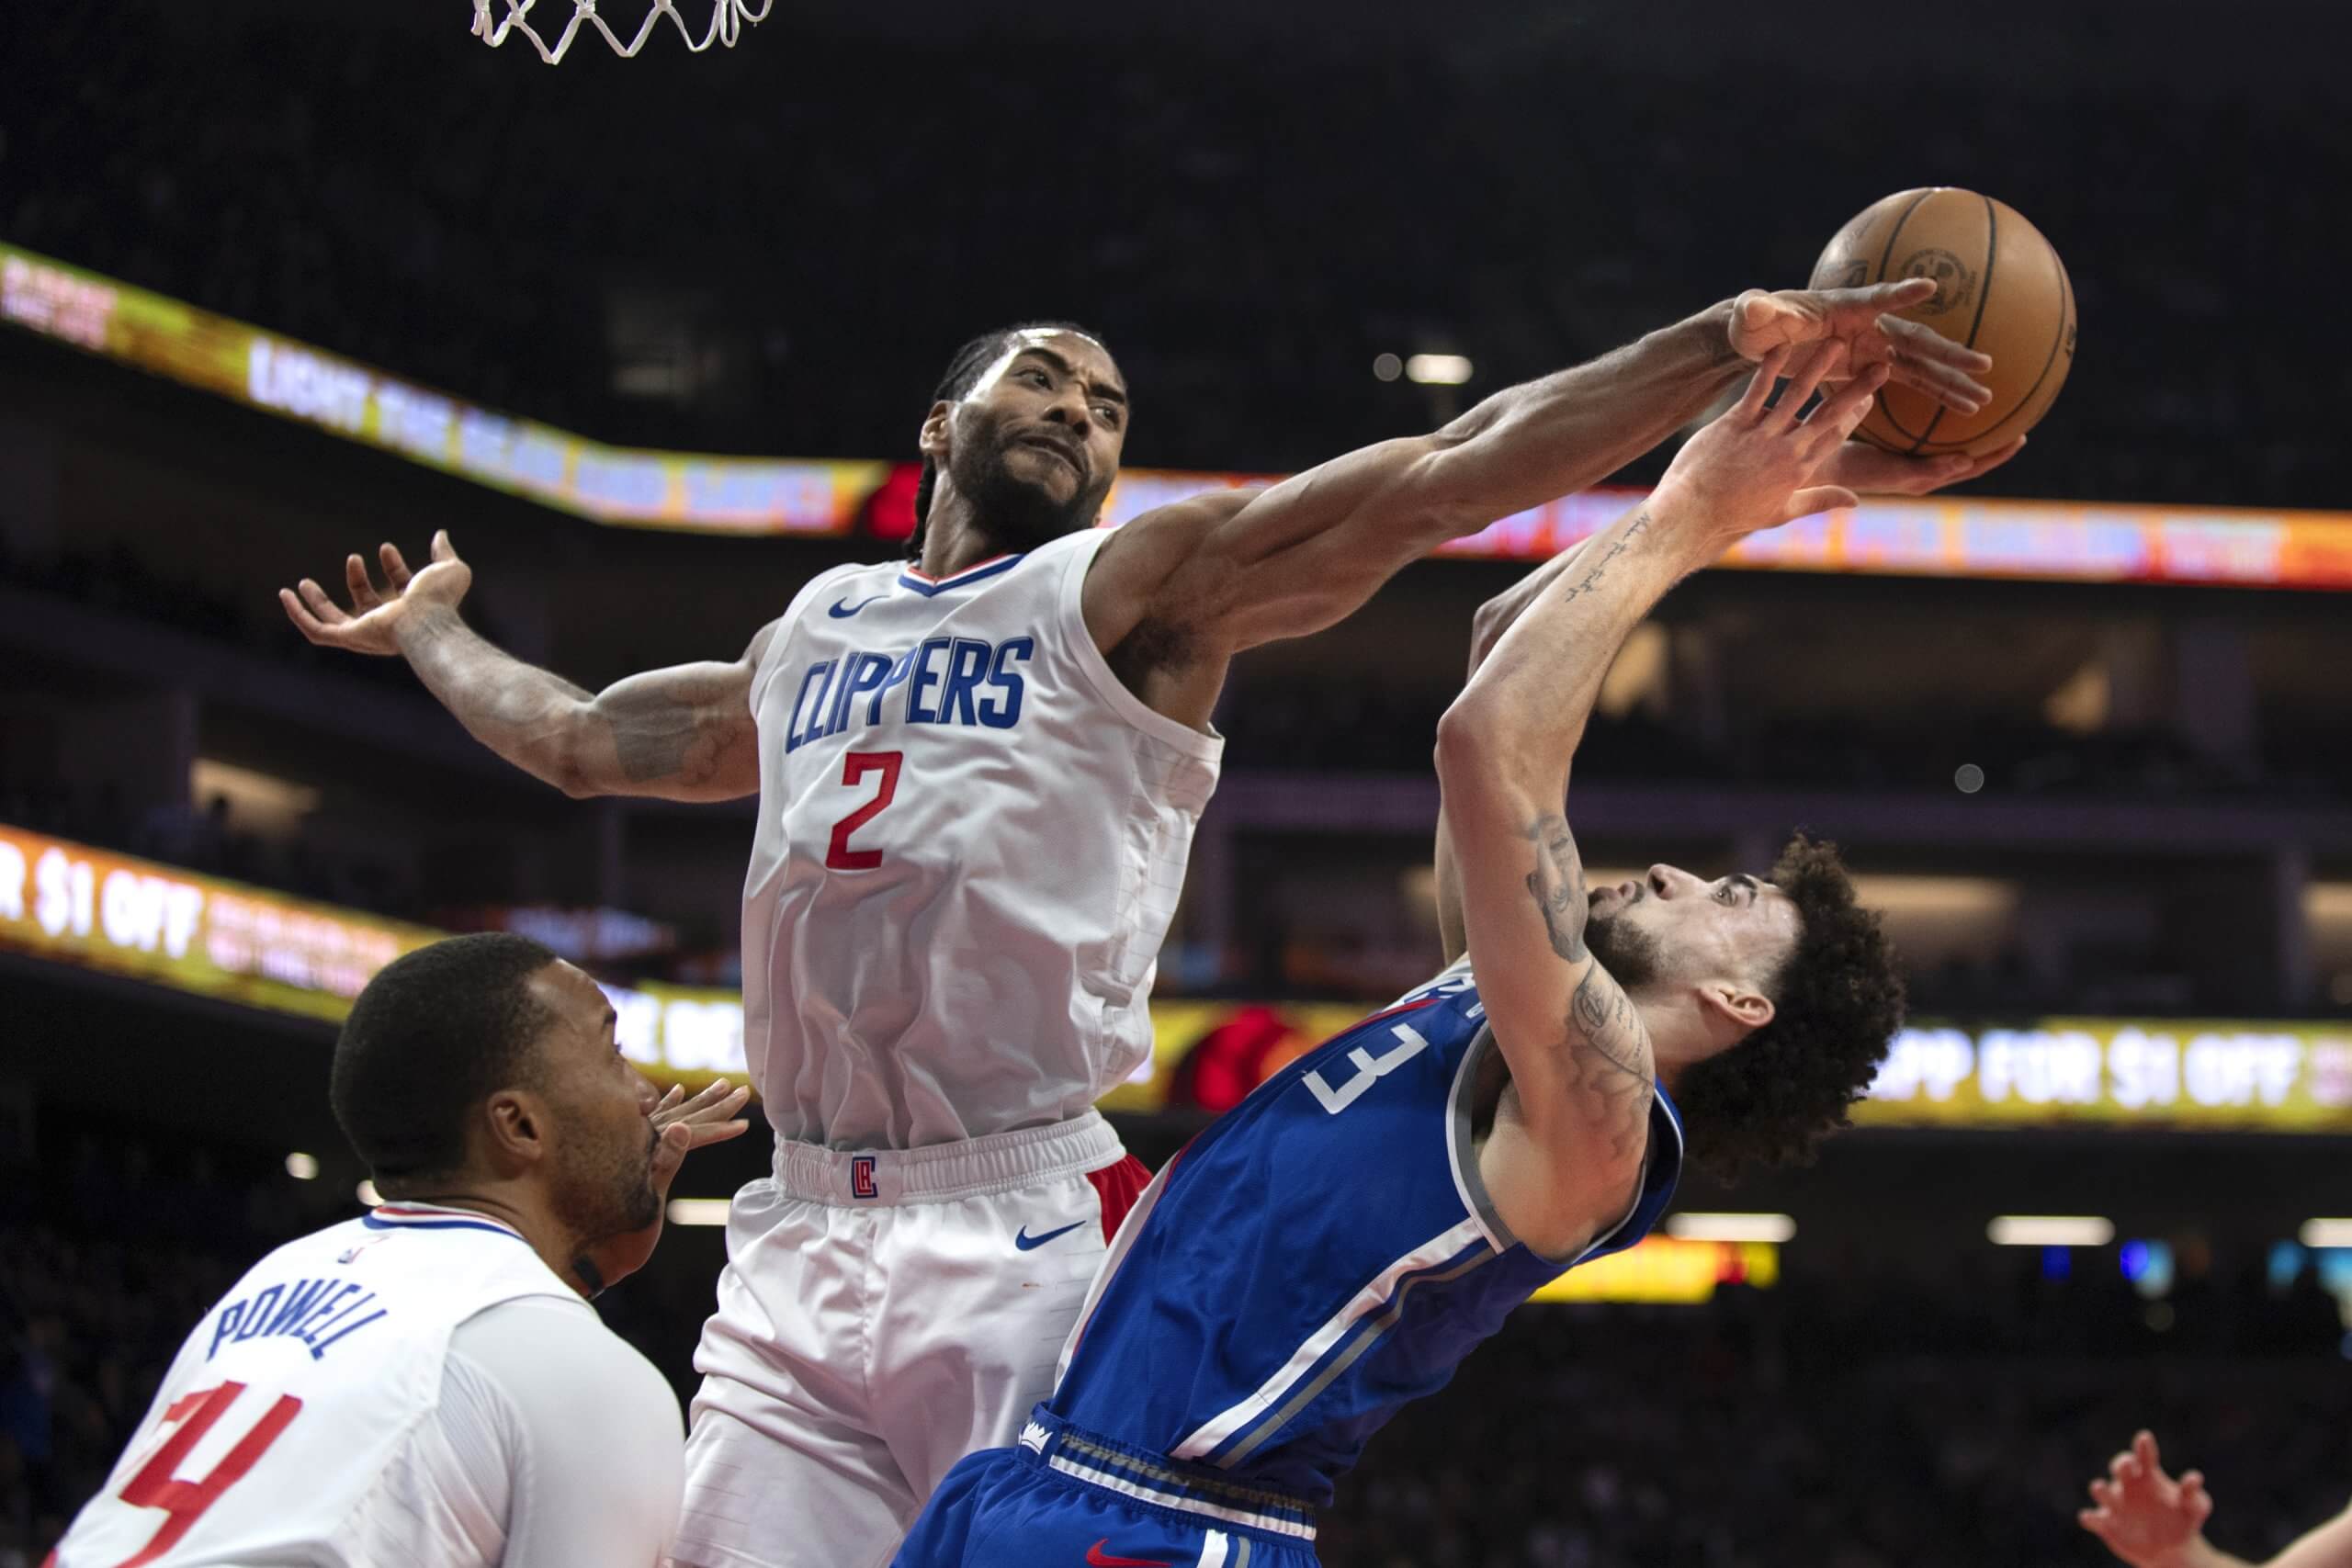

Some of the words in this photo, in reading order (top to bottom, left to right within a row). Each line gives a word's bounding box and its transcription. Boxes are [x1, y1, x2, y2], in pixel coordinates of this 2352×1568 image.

[786, 636, 1034, 754] CLIPPERS
[825, 750, 903, 870] 2
[35, 845, 93, 939] $1
[101, 868, 202, 959] OFF
[1301, 1021, 1430, 1115] 3
[206, 1279, 388, 1361] POWELL
